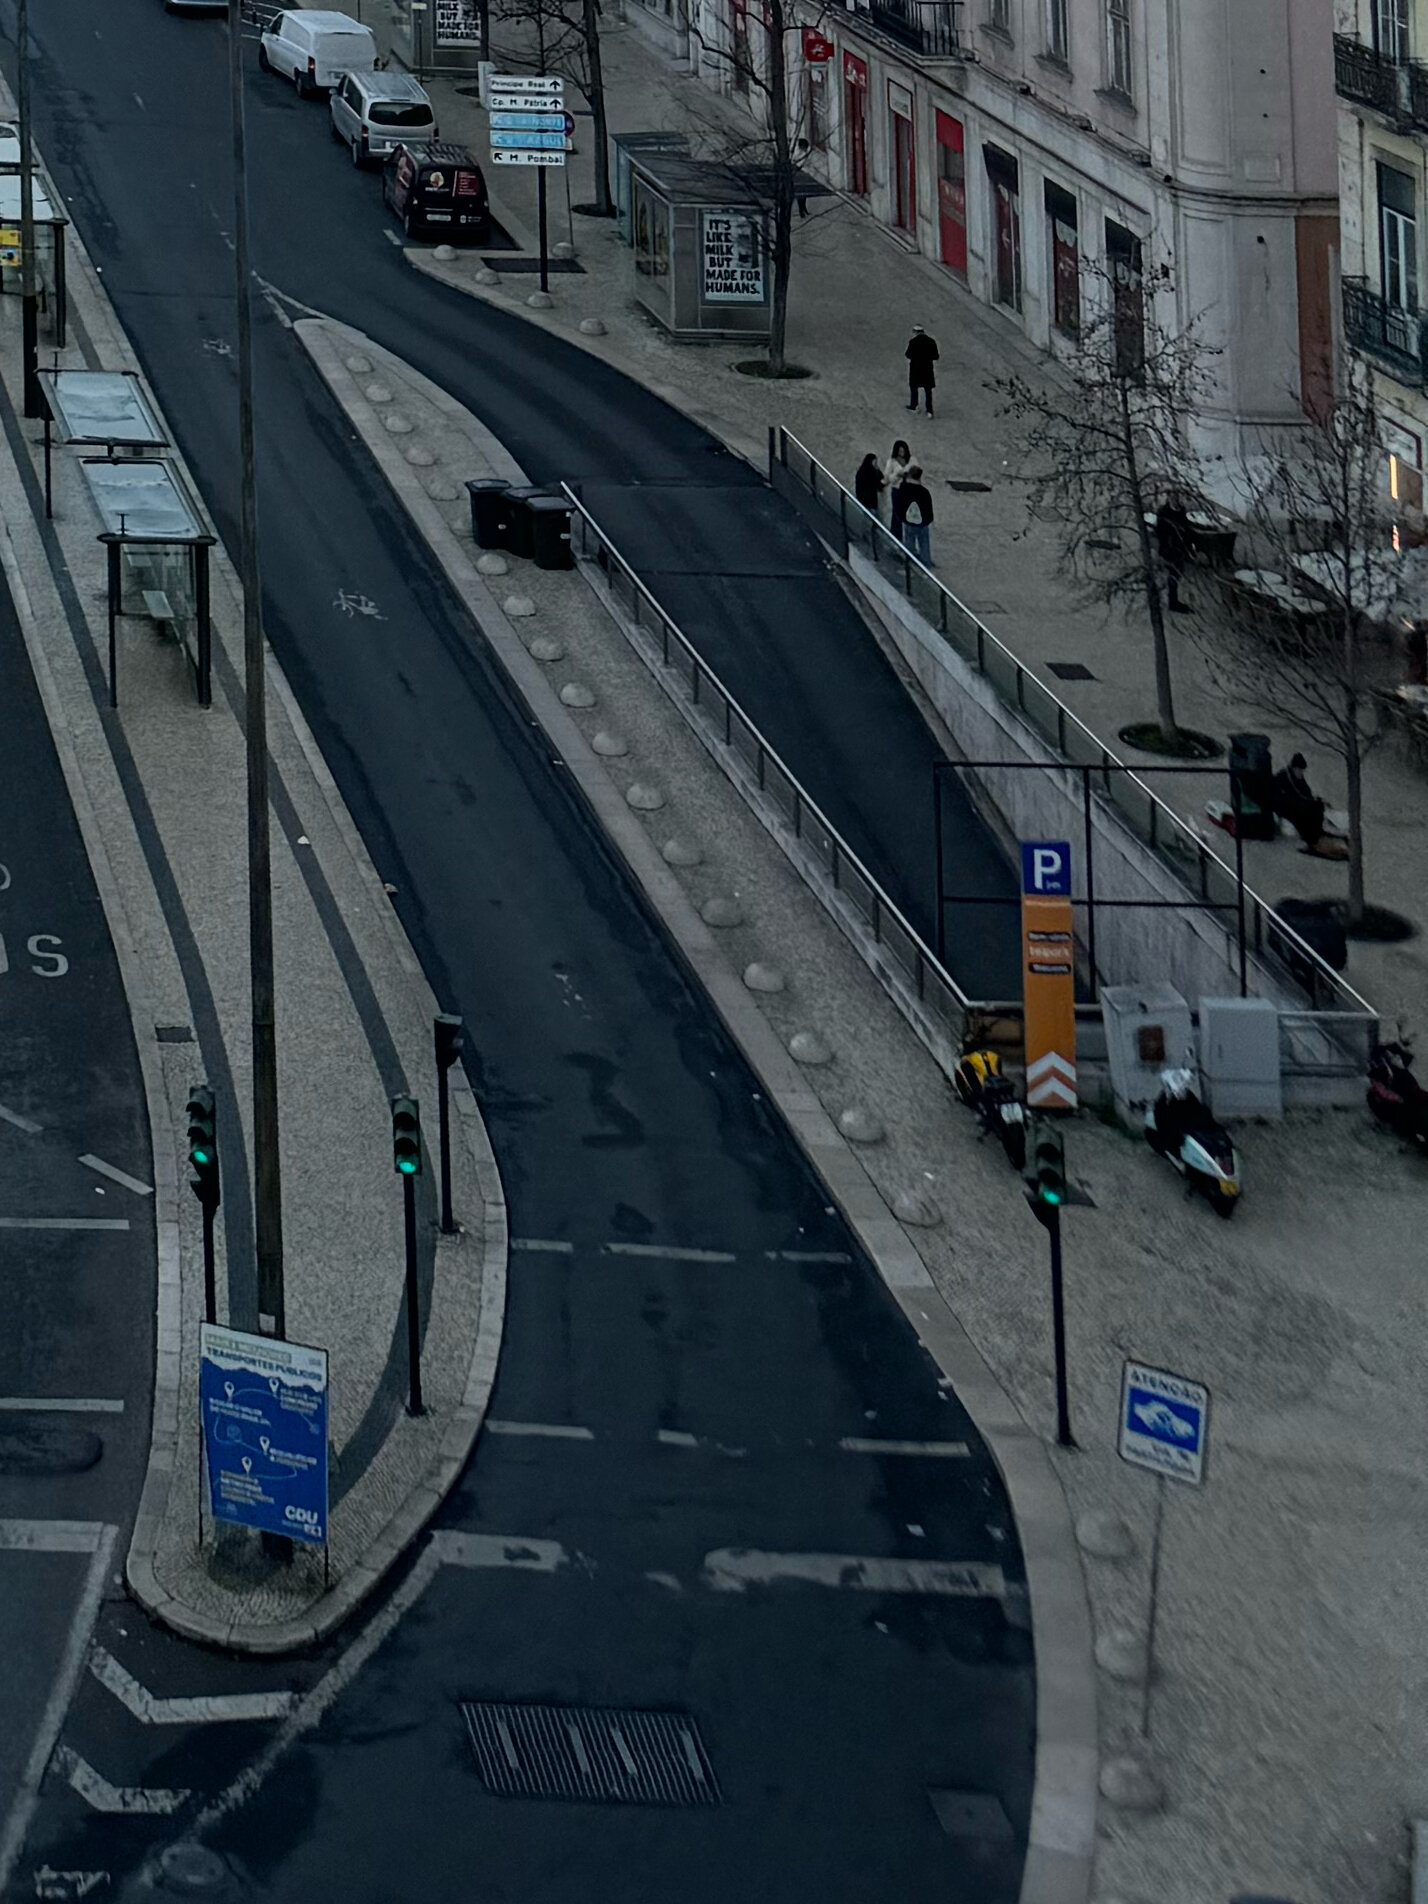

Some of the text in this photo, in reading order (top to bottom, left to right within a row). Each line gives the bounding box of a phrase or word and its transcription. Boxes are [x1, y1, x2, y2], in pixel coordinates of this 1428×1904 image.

[709, 219, 731, 231] IT'S
[706, 232, 733, 243] LIKE
[705, 244, 734, 255] MILK
[709, 256, 732, 268] BUT
[706, 269, 761, 282] MADE FOR
[1033, 848, 1062, 890] P
[285, 1504, 319, 1525] CDU
